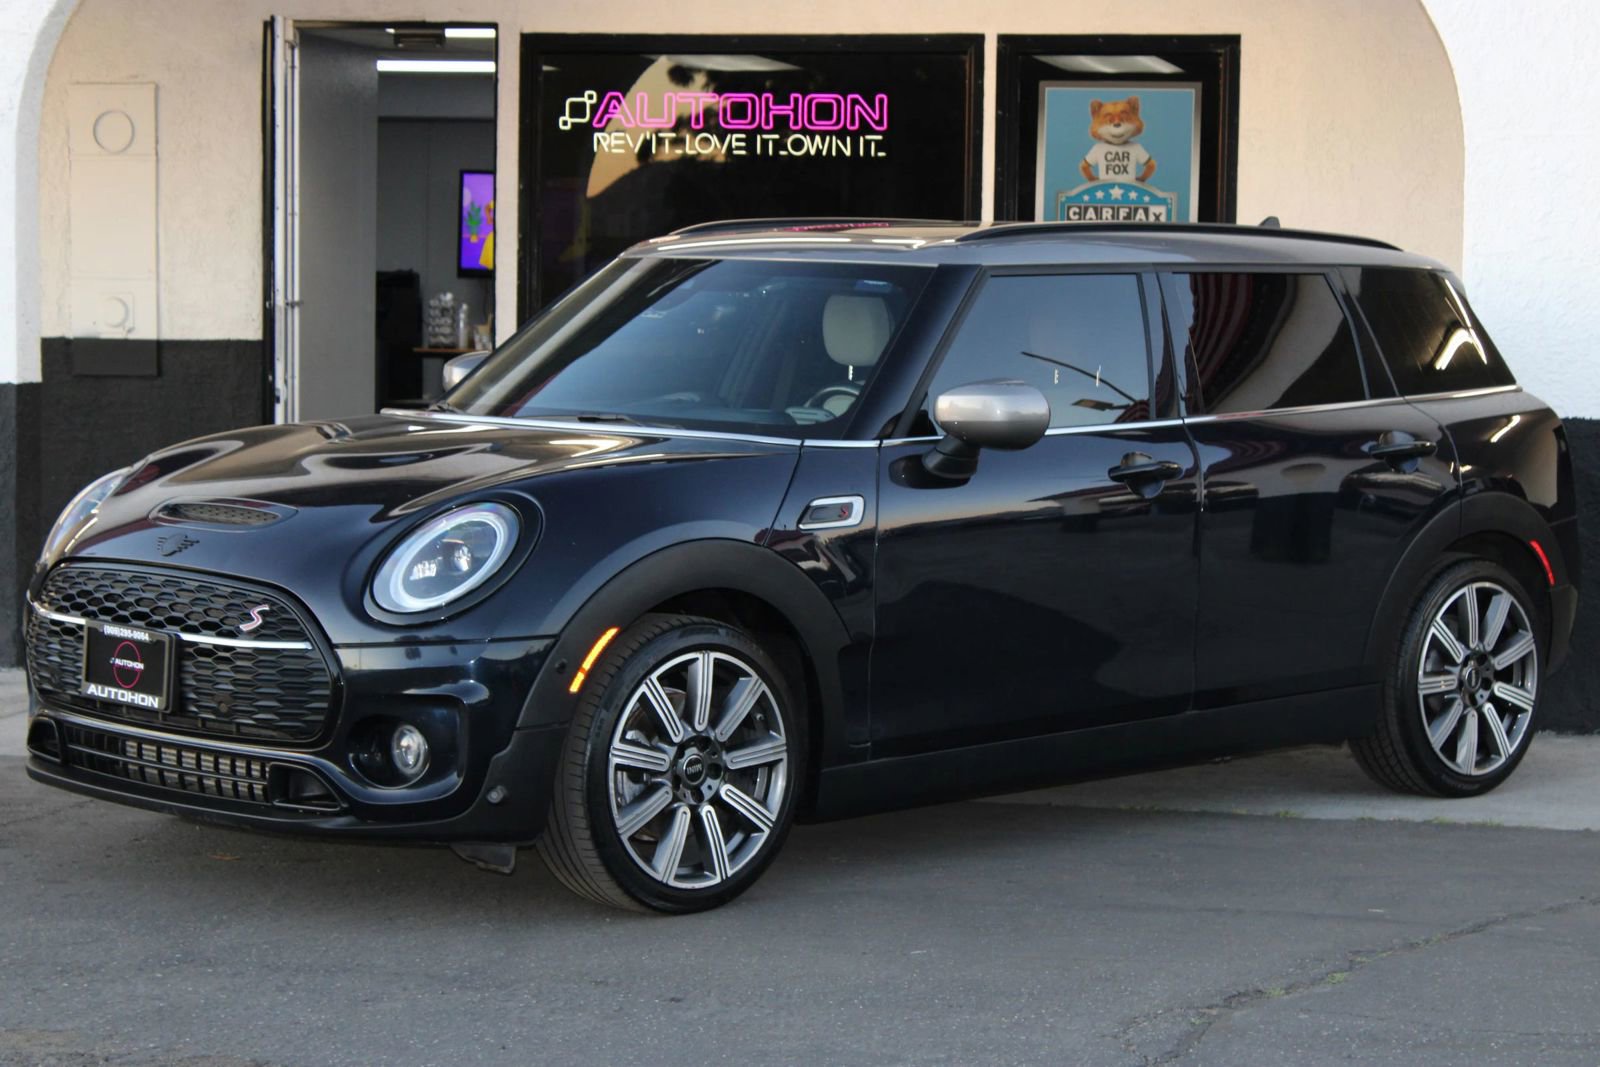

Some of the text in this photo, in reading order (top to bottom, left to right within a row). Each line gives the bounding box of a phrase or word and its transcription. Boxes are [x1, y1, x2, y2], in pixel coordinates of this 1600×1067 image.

[593, 92, 888, 131] AUTOHON
[1104, 151, 1131, 163] CAR
[1105, 163, 1129, 175] FOX
[1067, 205, 1164, 222] CARFAX
[87, 683, 159, 708] AUTOHON
